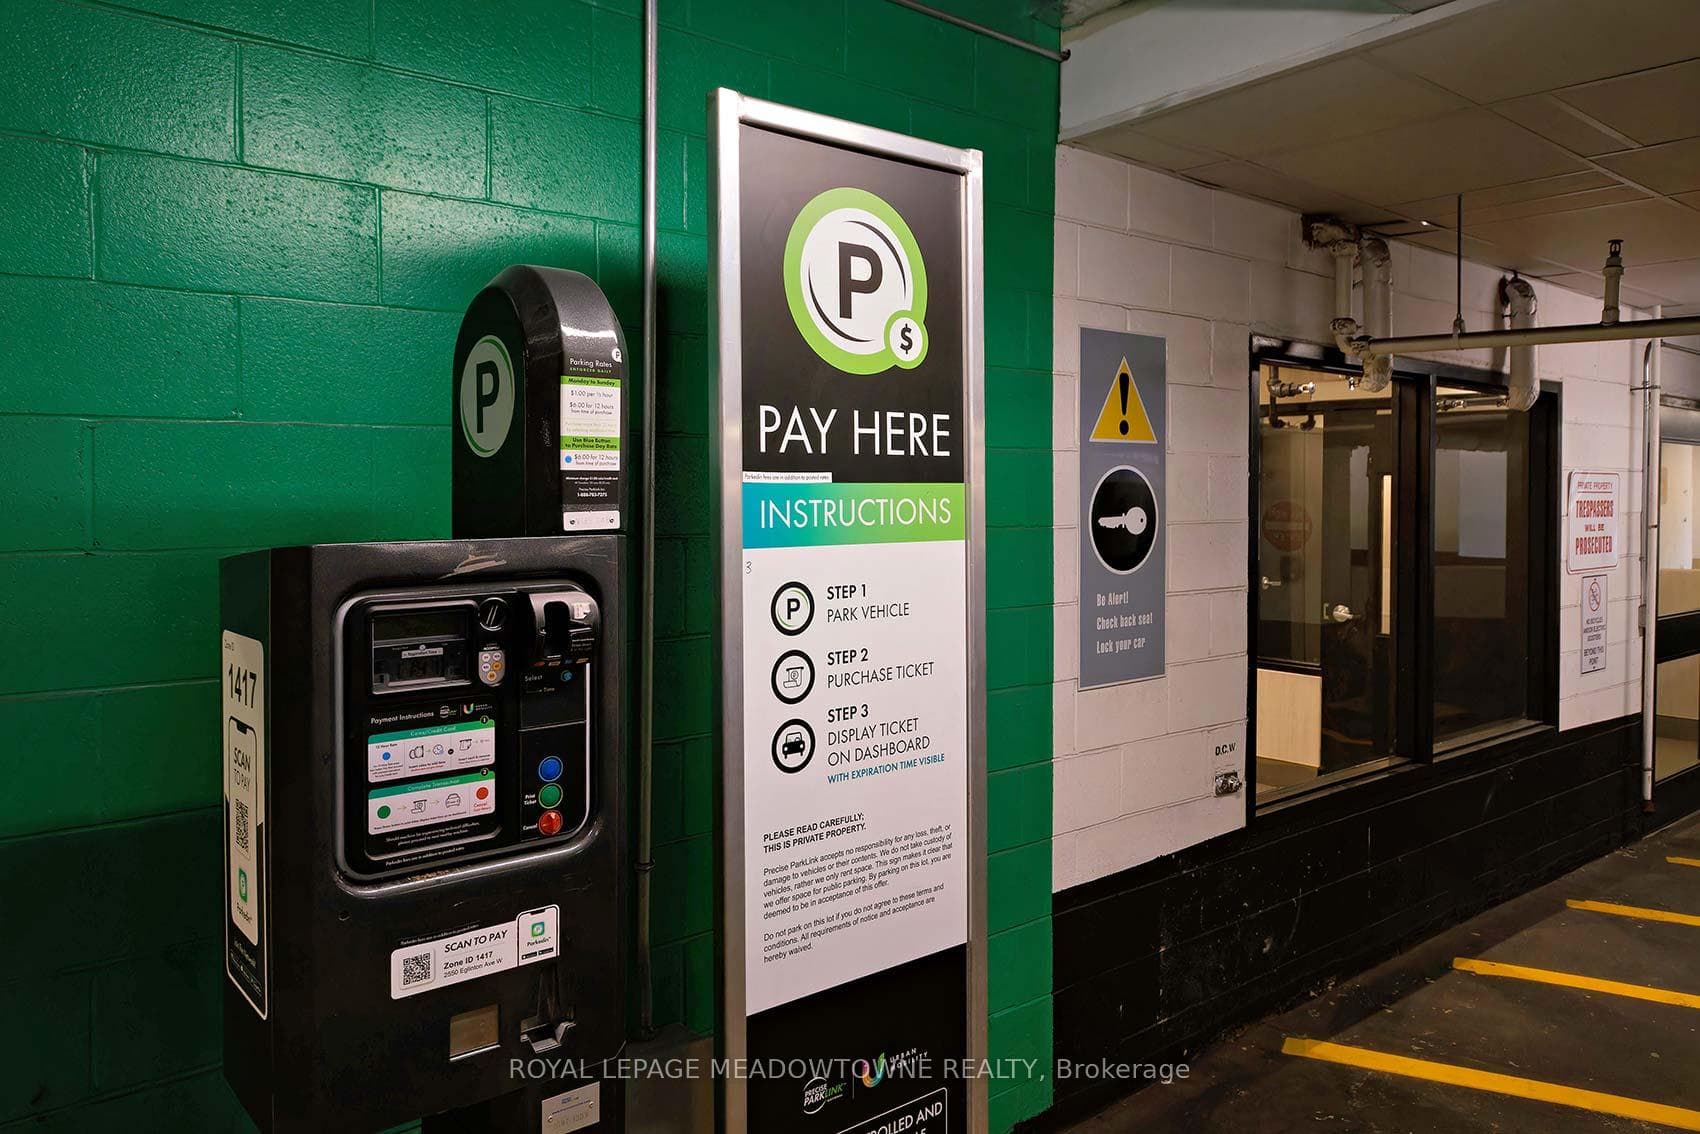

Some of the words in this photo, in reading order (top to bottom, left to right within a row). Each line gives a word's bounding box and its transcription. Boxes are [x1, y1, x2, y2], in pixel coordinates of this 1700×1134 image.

[839, 241, 883, 319] P
[900, 323, 913, 354] $
[569, 358, 594, 368] Parking
[595, 360, 613, 368] Rates
[476, 360, 500, 434] P
[760, 405, 837, 454] PAY
[854, 410, 950, 457] HERE
[761, 498, 951, 528] INSTRUCTIONS
[1576, 500, 1614, 518] TRESPASSERS
[1585, 524, 1595, 532] WILL
[1598, 523, 1604, 531] BE
[1576, 536, 1613, 555] PROSECUTED
[827, 585, 856, 600] STEP
[861, 584, 866, 597] 1
[1096, 593, 1106, 606] Be
[1107, 591, 1129, 606] Alert!
[787, 598, 800, 620] P
[827, 607, 857, 622] PARK
[862, 602, 910, 620] VEHICLE
[1096, 615, 1118, 630] Check
[1119, 613, 1137, 627] back
[827, 649, 857, 665] STEP
[860, 648, 868, 662] 2
[1096, 640, 1114, 654] Lock
[1115, 639, 1132, 653] your
[1133, 637, 1146, 649] car
[229, 663, 257, 709] 1417
[525, 674, 543, 682] Select
[828, 667, 893, 689] PURCHASE
[896, 662, 935, 679] TICKET
[371, 715, 398, 725] Payment
[399, 711, 434, 720] Instructions
[828, 706, 857, 723] STEP
[860, 704, 869, 718] 3
[828, 724, 877, 746] DISPLAY
[880, 717, 919, 736] TICKET
[234, 747, 251, 772] SCAN
[828, 750, 850, 766] ON
[855, 735, 930, 762] DASHBOARD
[828, 771, 849, 784] WITH
[852, 759, 898, 780] EXPIRATION
[900, 757, 917, 769] TIME
[919, 753, 945, 766] VISIBLE
[764, 828, 794, 841] PLEASE
[797, 822, 818, 835] READ
[764, 843, 781, 853] THIS
[783, 840, 791, 849] IS
[793, 832, 824, 846] PRIVATE
[826, 823, 866, 839] PROPERTY.
[764, 865, 788, 876] Precise
[790, 856, 818, 869] ParkLink
[820, 850, 844, 862] accepts
[855, 838, 893, 853] responsibility
[916, 830, 929, 838] loss,
[764, 876, 790, 887] damage
[800, 866, 826, 877] vehicles
[836, 859, 850, 869] their
[851, 853, 877, 864] contents.
[880, 849, 889, 857] We
[910, 841, 922, 849] take
[924, 836, 945, 846] custody
[946, 832, 952, 840] of
[764, 907, 791, 920] deemed
[792, 904, 799, 912] to
[800, 901, 809, 910] be
[810, 899, 816, 907] in
[818, 888, 853, 905] acceptance
[855, 886, 861, 894] of
[862, 884, 873, 892] this
[764, 937, 798, 952] conditions.
[800, 932, 809, 942] All
[810, 921, 851, 938] requirements
[852, 917, 859, 925] of
[860, 913, 878, 924] notice
[879, 908, 891, 918] and
[892, 899, 925, 914] acceptance
[926, 896, 935, 904] are
[444, 938, 472, 953] SCAN
[474, 935, 487, 945] TO
[489, 930, 508, 942] PAY
[764, 951, 787, 963] hereby
[788, 942, 812, 955] waived.
[444, 960, 463, 970] Zone
[465, 956, 474, 964] ID
[476, 951, 493, 961] 1417
[484, 960, 494, 968] Ave
[804, 1084, 827, 1098] PRECISE
[916, 1102, 943, 1124] AND
